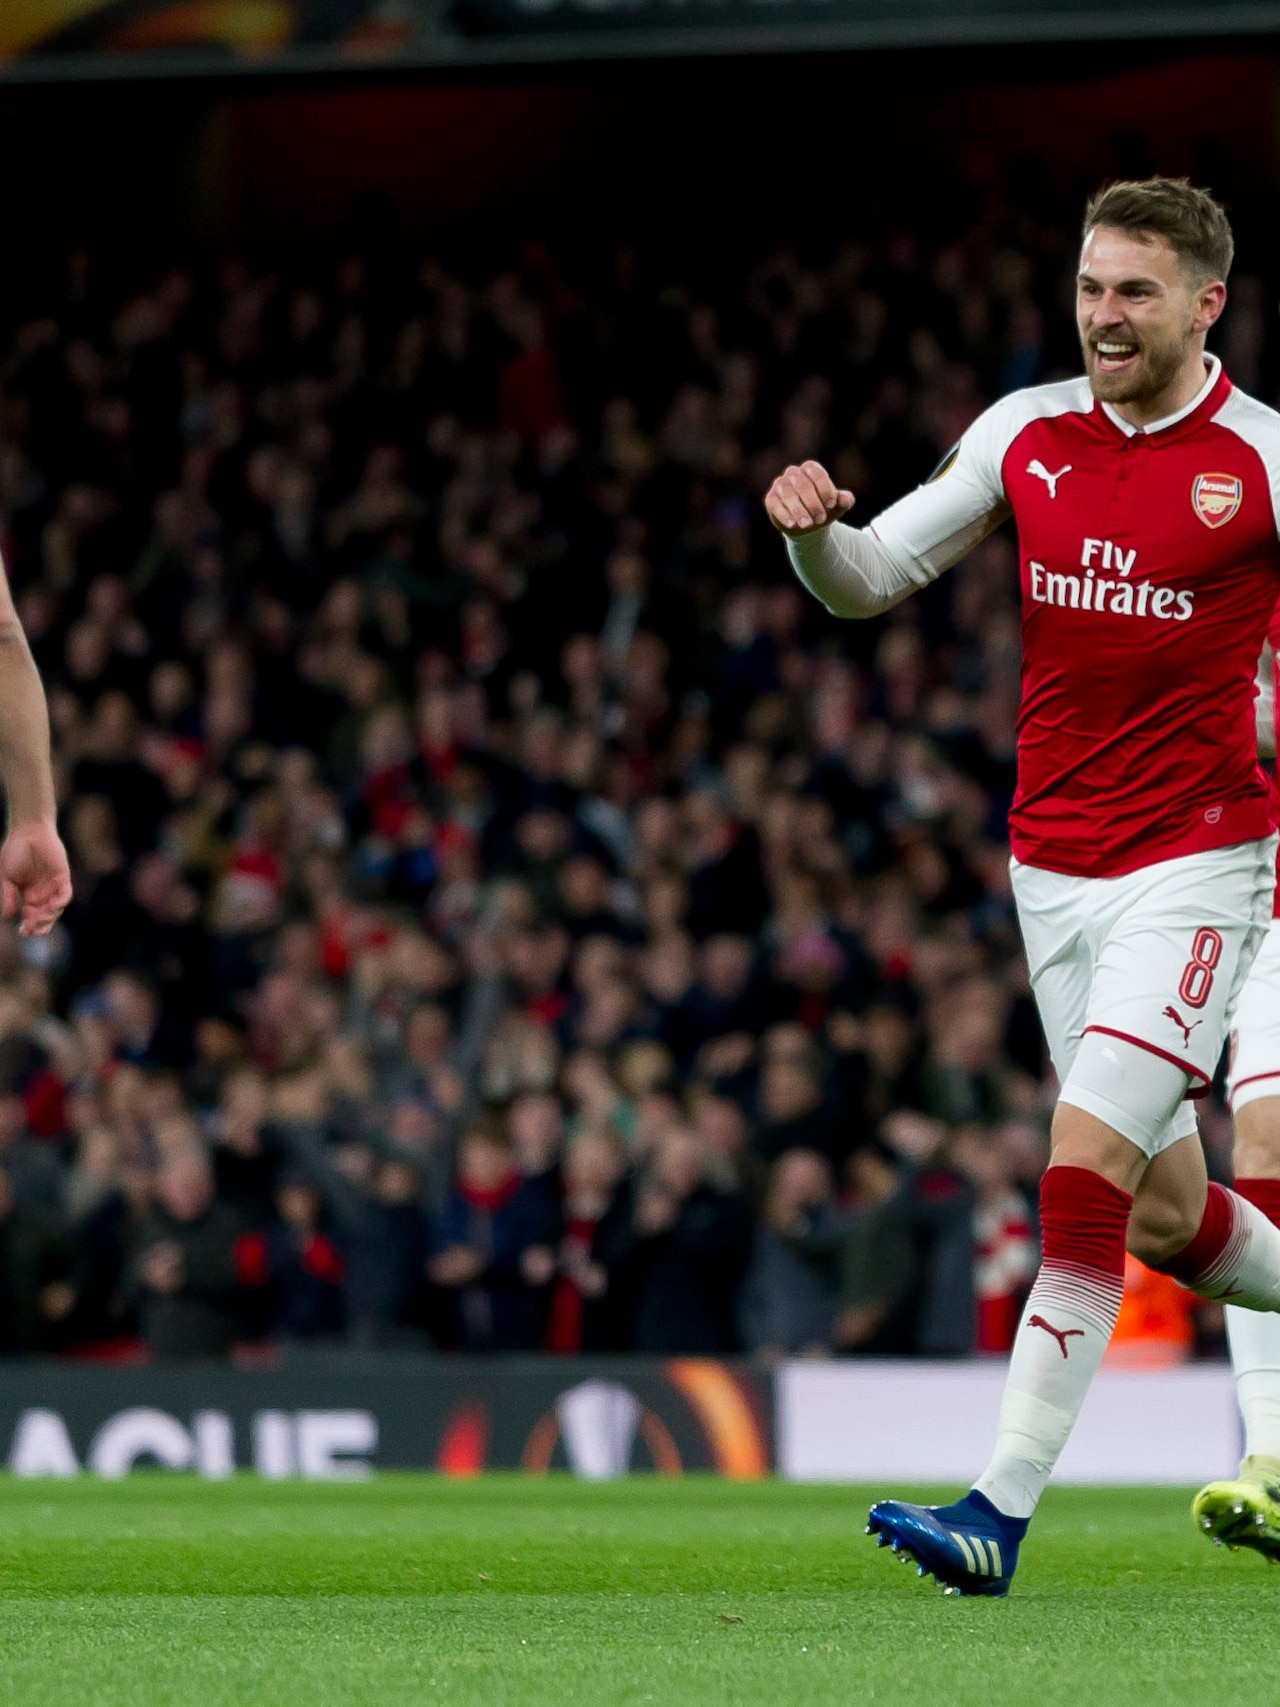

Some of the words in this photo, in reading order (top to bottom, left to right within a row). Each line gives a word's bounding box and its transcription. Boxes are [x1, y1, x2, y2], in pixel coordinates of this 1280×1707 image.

[1080, 537, 1137, 577] Fly
[1029, 560, 1195, 621] Emirates
[1178, 926, 1223, 1009] 8
